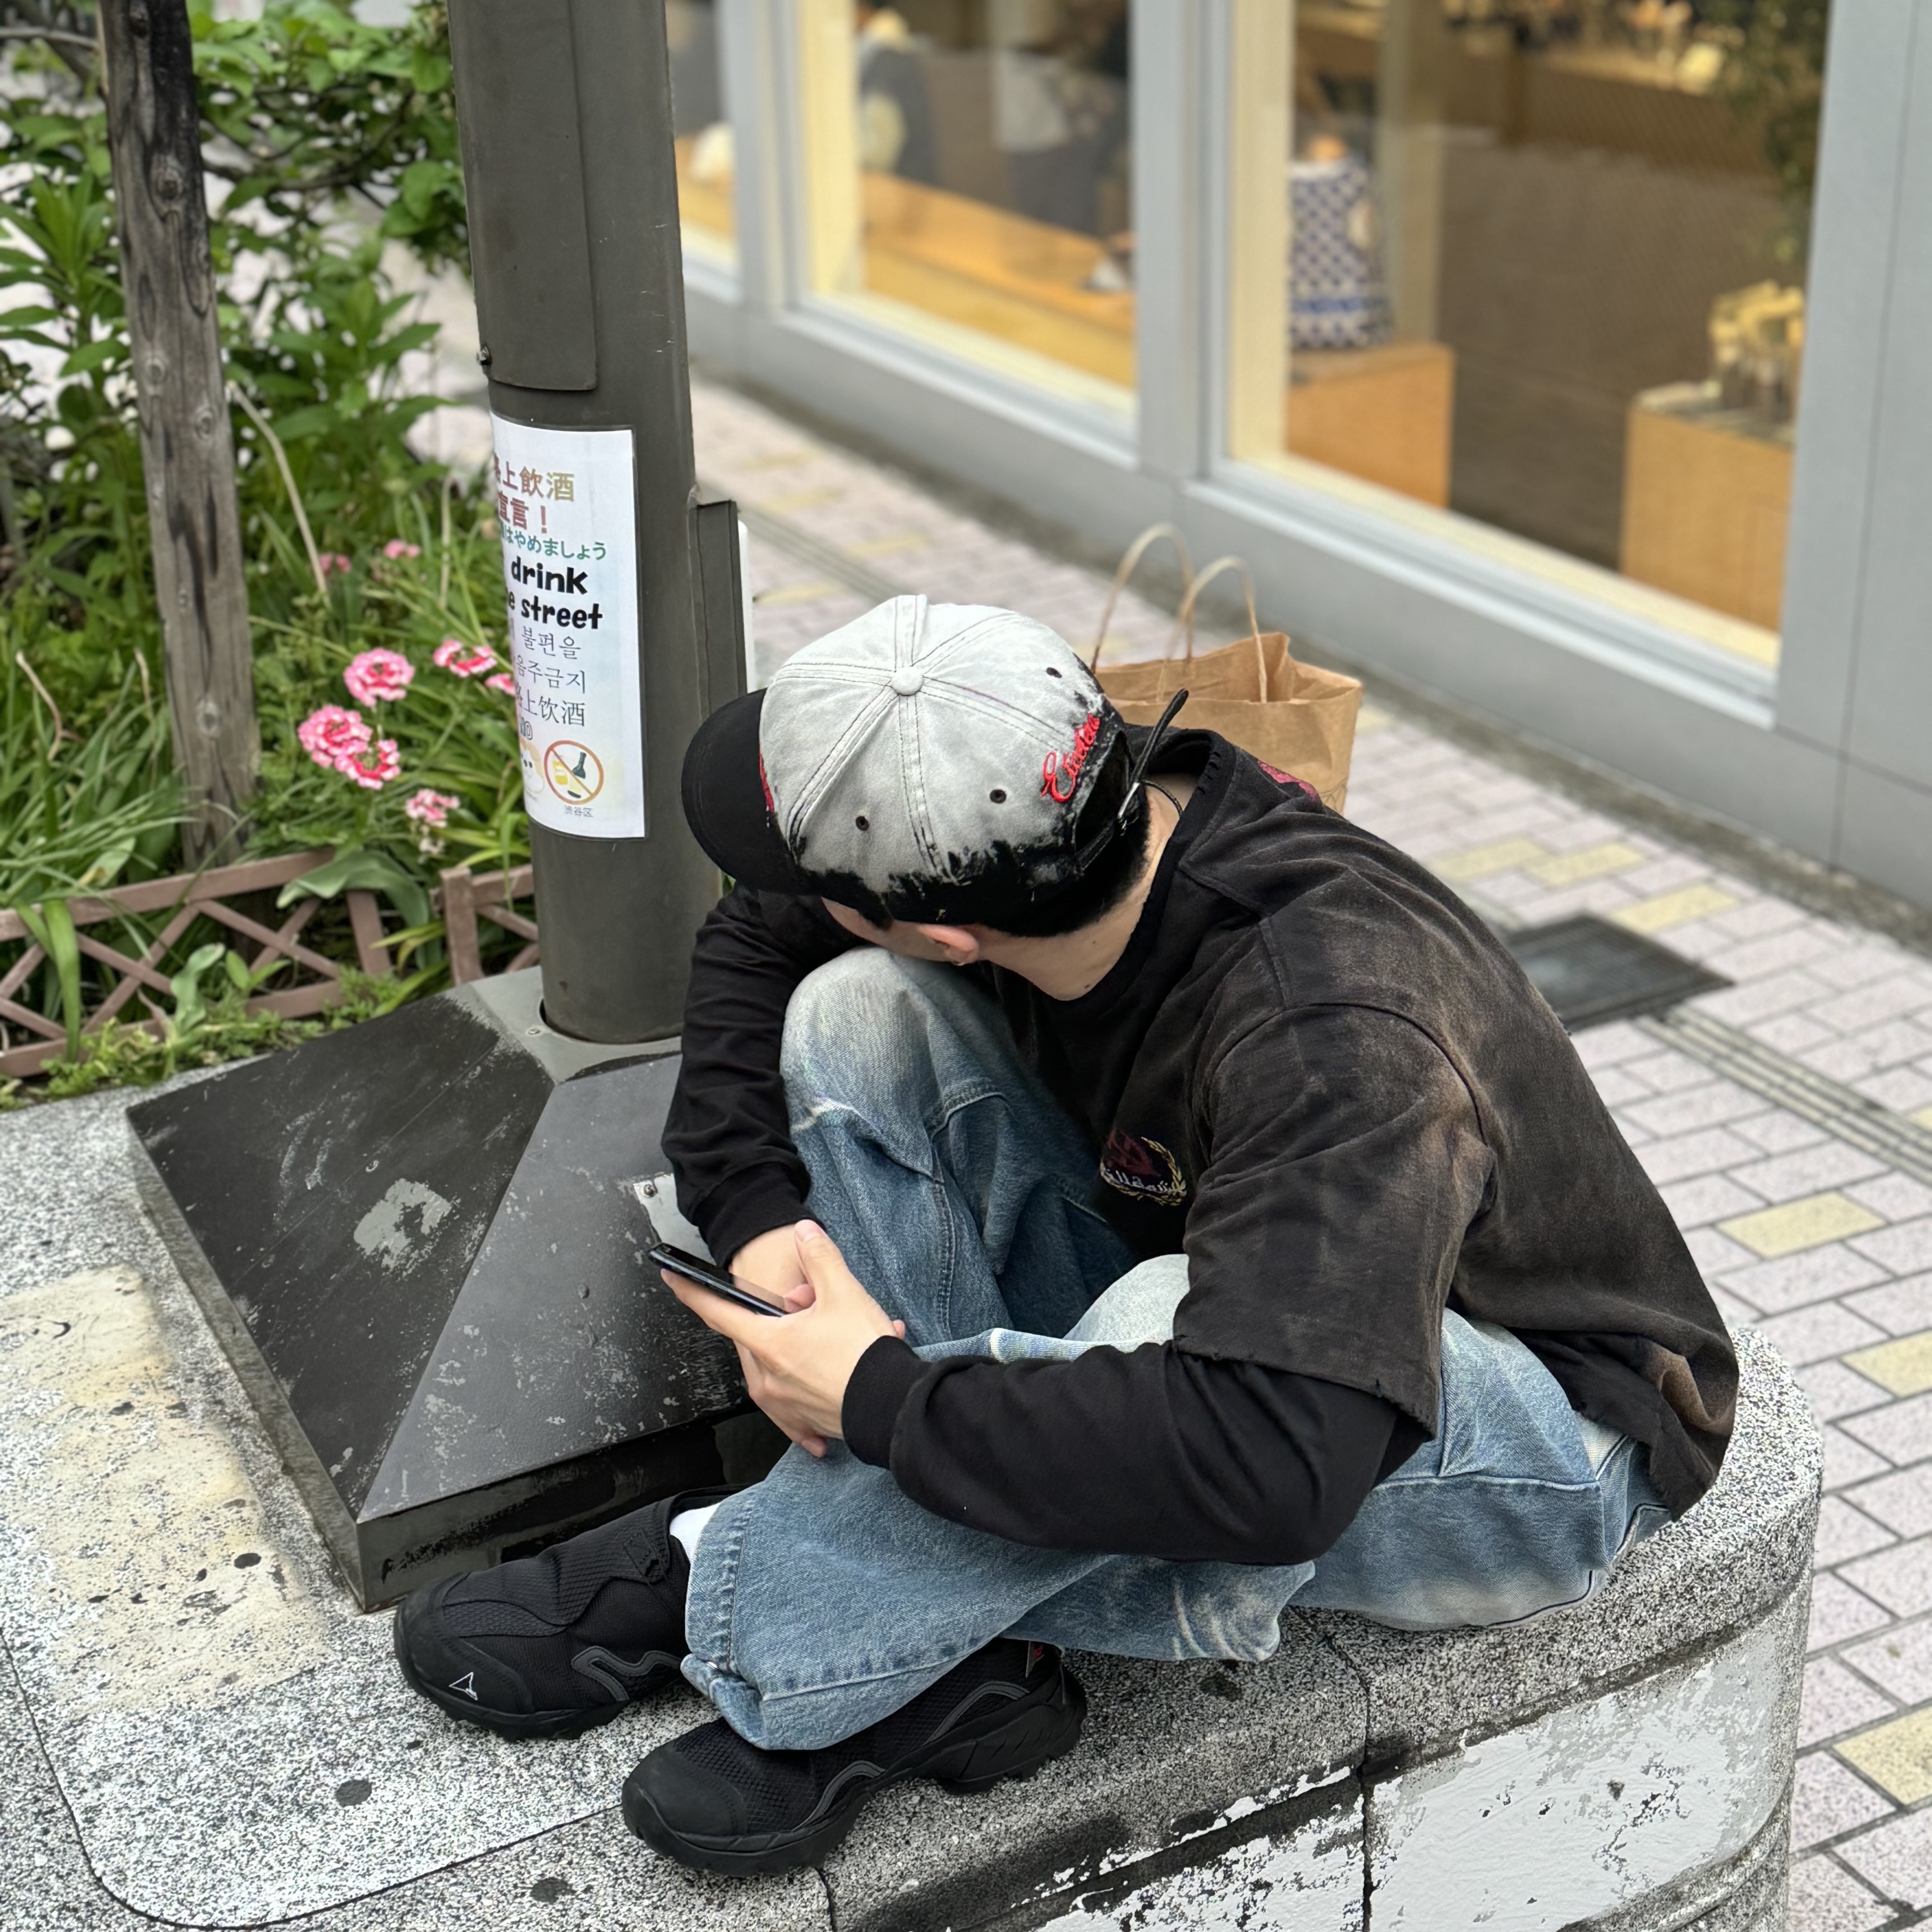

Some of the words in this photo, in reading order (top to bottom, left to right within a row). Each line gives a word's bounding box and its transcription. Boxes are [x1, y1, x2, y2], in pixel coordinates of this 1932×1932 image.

[499, 519, 606, 560] はやめましょう
[511, 556, 588, 595] drink
[521, 595, 603, 630] street
[522, 625, 581, 660] 불편을
